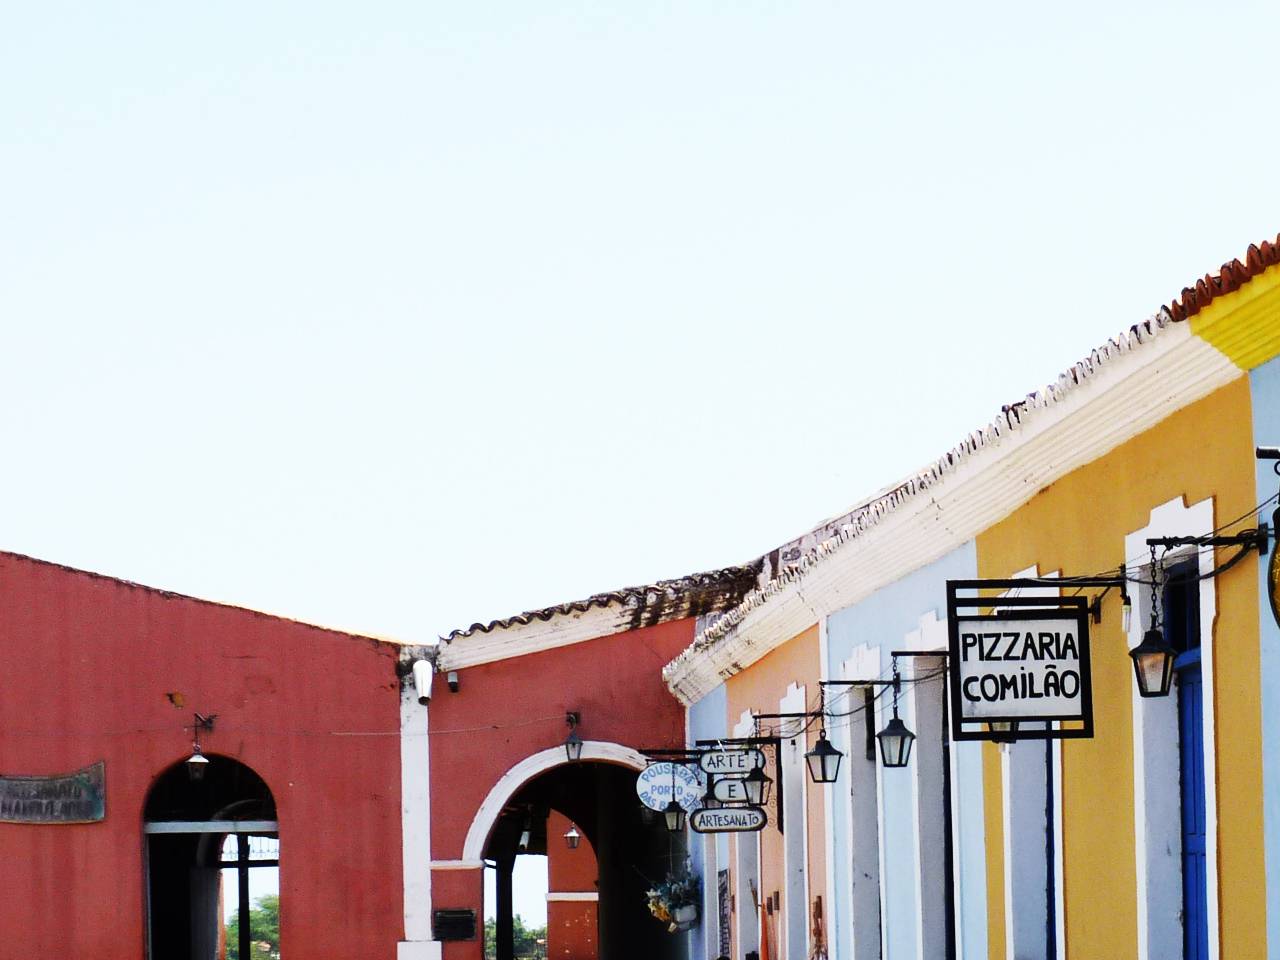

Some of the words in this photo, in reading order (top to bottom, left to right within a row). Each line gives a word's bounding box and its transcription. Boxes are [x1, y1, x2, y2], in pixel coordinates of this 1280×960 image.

[962, 632, 1079, 661] PIZZARIA
[707, 754, 745, 768] ARTE
[728, 784, 736, 798] E
[640, 791, 656, 808] DAS
